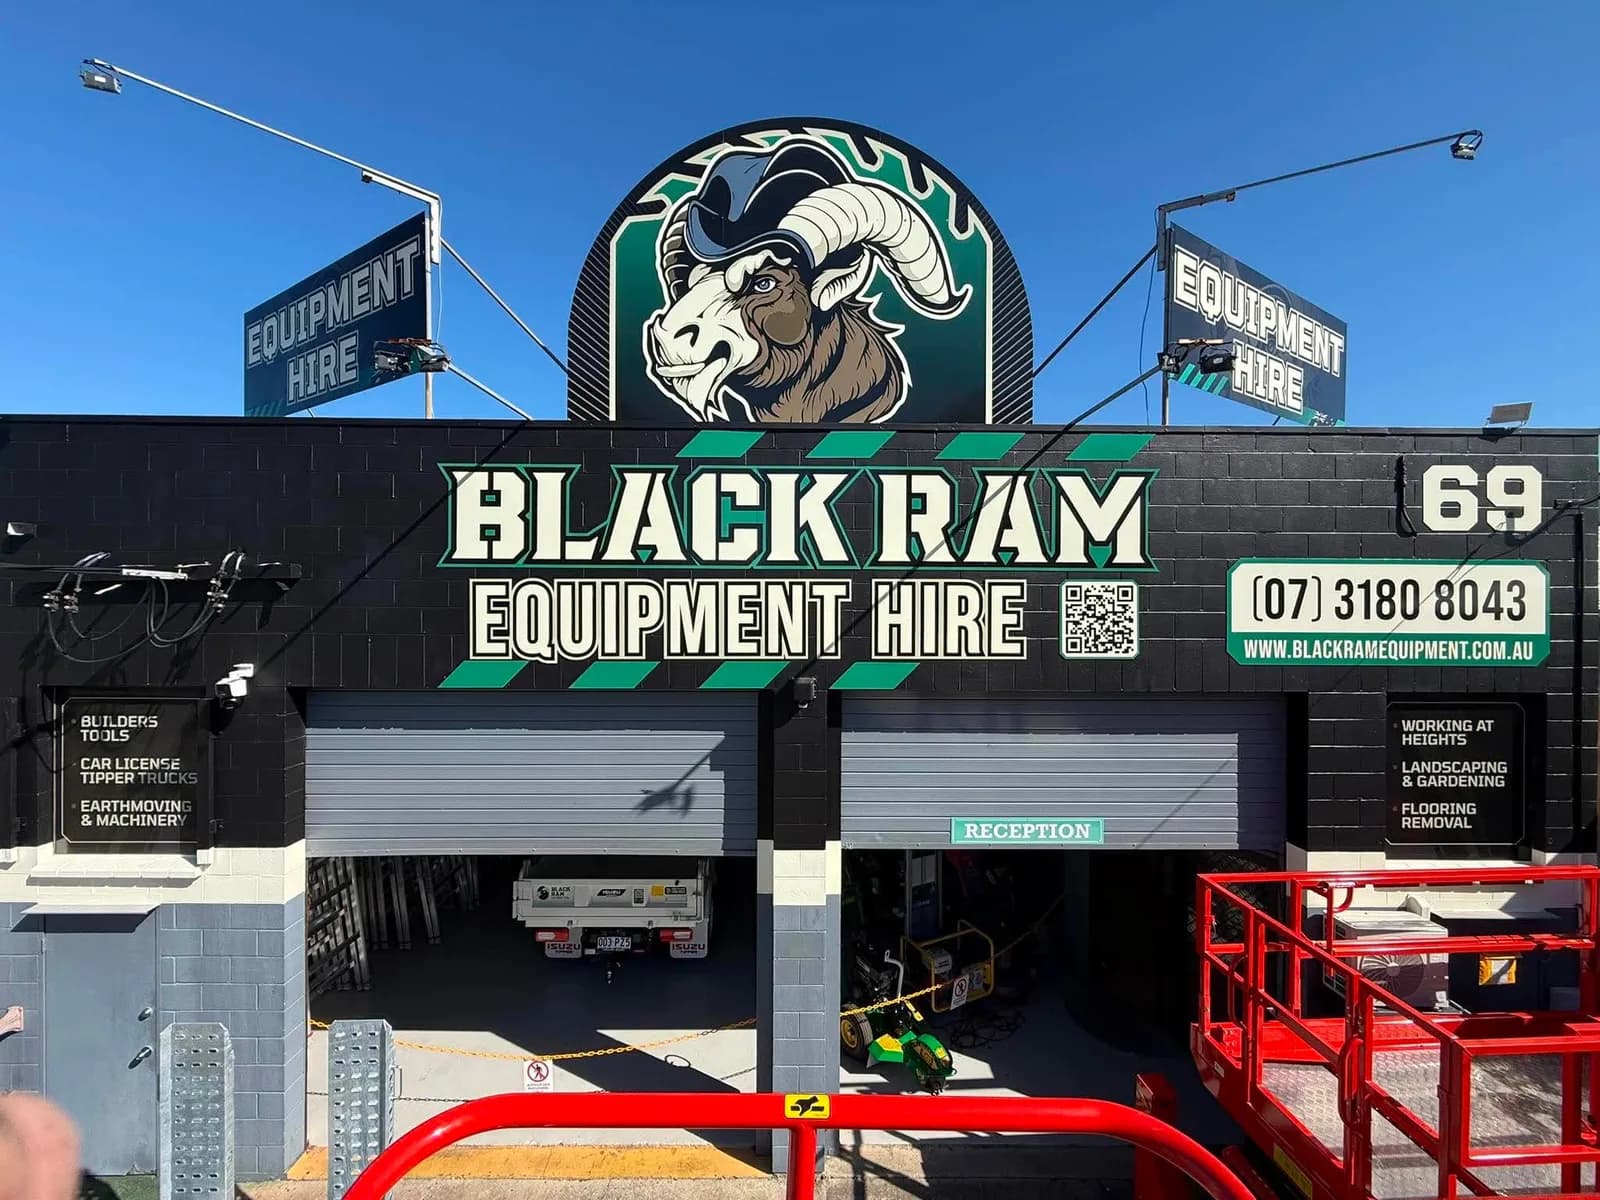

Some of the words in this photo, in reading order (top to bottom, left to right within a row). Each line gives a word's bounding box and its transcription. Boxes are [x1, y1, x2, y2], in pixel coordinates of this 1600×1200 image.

[247, 234, 421, 369] EQUIPMENT
[1174, 244, 1345, 378] EQUIPMENT
[286, 329, 359, 406] HIRE
[1232, 338, 1304, 415] HIRE
[1422, 464, 1543, 532] 69
[450, 470, 850, 562] BLACK
[876, 473, 1147, 564] RAM
[1253, 575, 1322, 622] (07)
[1334, 578, 1420, 621] 3180
[1434, 579, 1527, 621] 8043
[469, 578, 852, 664] EQUIPMENT
[871, 579, 1027, 660] HIRE
[1244, 639, 1533, 661] WWW.BLACKRAMEQUIPMENT.COM.AU
[80, 715, 159, 728] BUILDERS
[1401, 719, 1473, 732] WORKING
[1475, 719, 1495, 732] AT
[80, 729, 130, 742] TOOLS
[1401, 733, 1468, 746] HEIGHTS
[80, 758, 112, 770] CAR
[115, 758, 181, 770] LICENSE
[1401, 761, 1508, 774] LANDSCAPING
[80, 772, 135, 784] TIPPER
[137, 772, 199, 784] TRUCKS
[1401, 775, 1414, 788] &
[1416, 775, 1506, 788] GARDENING
[80, 800, 193, 812] EARTHMOVING
[1401, 802, 1478, 815] FLOORING
[80, 814, 93, 827] &
[96, 814, 188, 827] MACHINERY
[1401, 816, 1473, 829] REMOVAL
[963, 822, 1092, 839] RECEPTION
